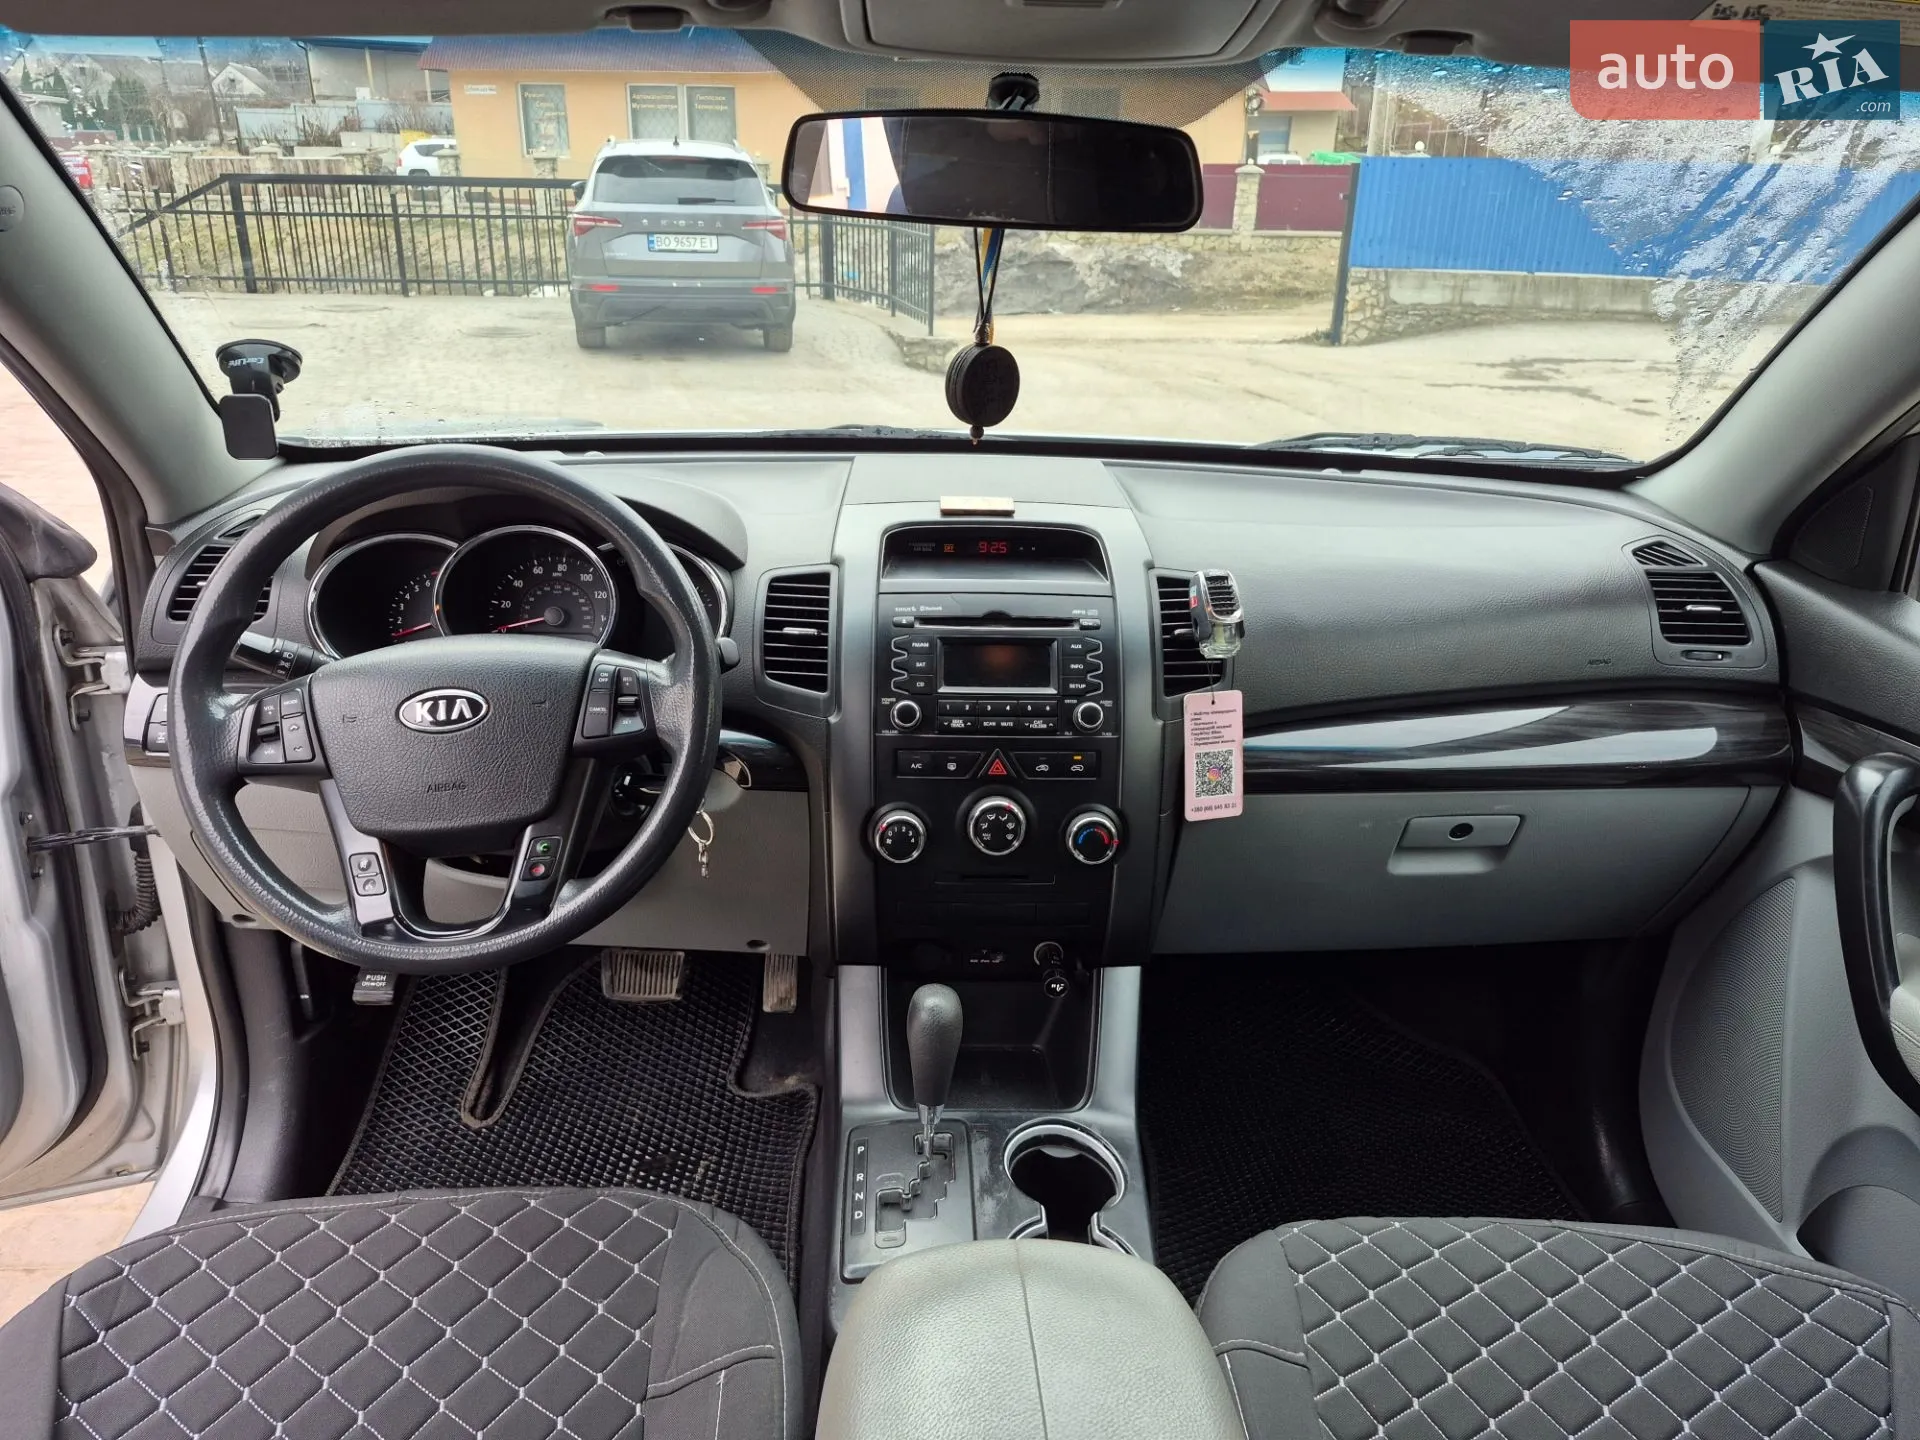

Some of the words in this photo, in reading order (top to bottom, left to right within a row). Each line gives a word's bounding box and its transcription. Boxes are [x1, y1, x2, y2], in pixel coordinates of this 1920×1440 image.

[674, 236, 697, 248] 9657
[979, 541, 1007, 553] 9:25
[533, 566, 543, 575] 60
[557, 563, 567, 572] 80
[580, 573, 593, 582] 100
[512, 579, 523, 588] 40
[594, 591, 607, 599] 120
[399, 603, 404, 611] 3
[501, 600, 511, 609] 20
[397, 616, 402, 624] 2
[415, 699, 473, 723] KIA
[426, 782, 467, 794] AIRBAG
[857, 1146, 865, 1154] P
[856, 1173, 864, 1181] R
[855, 1192, 864, 1200] N
[854, 1211, 863, 1219] D
